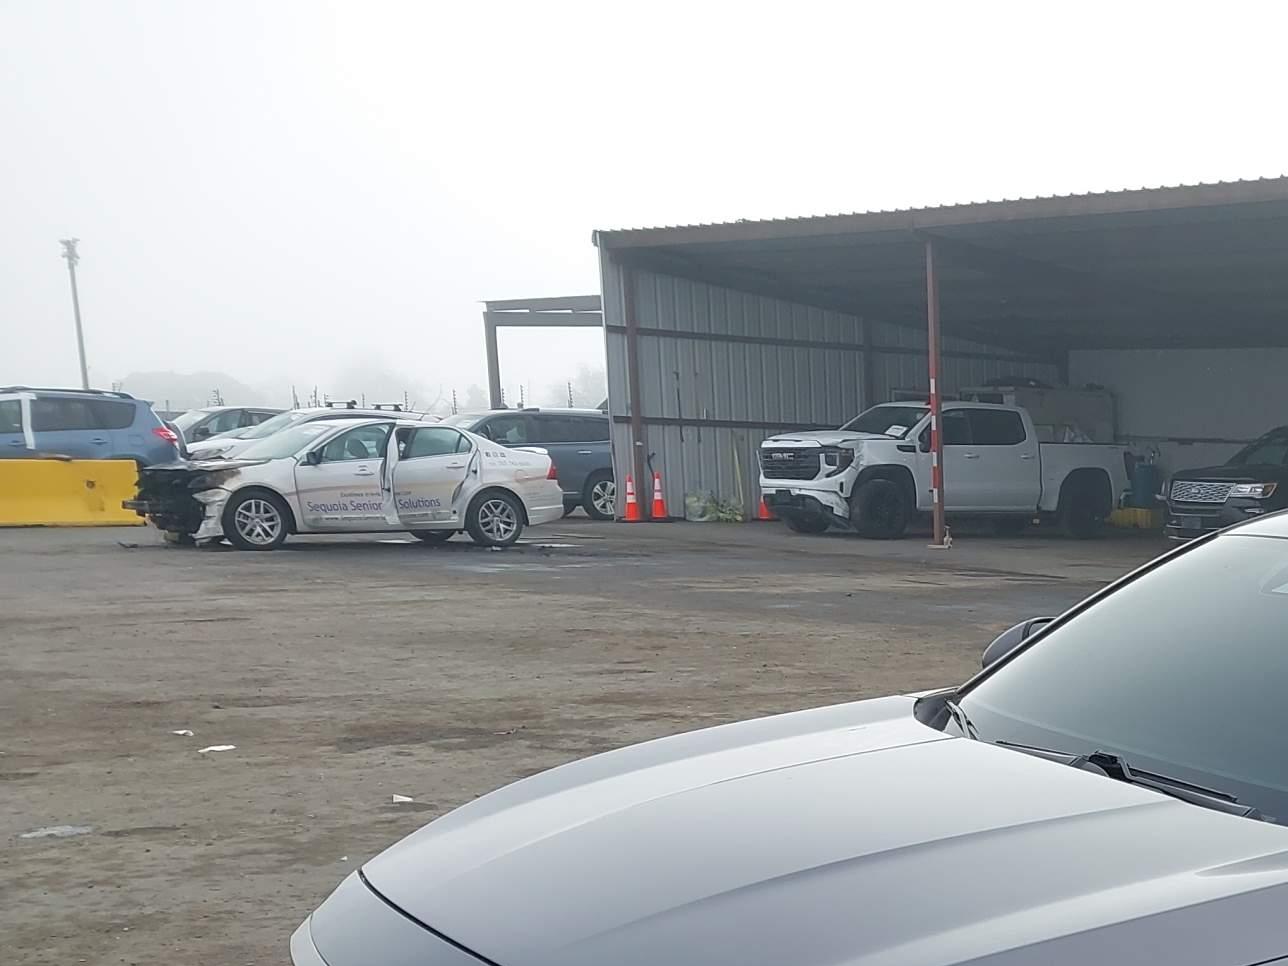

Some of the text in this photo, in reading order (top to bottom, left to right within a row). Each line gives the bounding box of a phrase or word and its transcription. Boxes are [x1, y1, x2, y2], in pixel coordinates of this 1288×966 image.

[306, 498, 441, 514] Sequoia Senior Solutions
